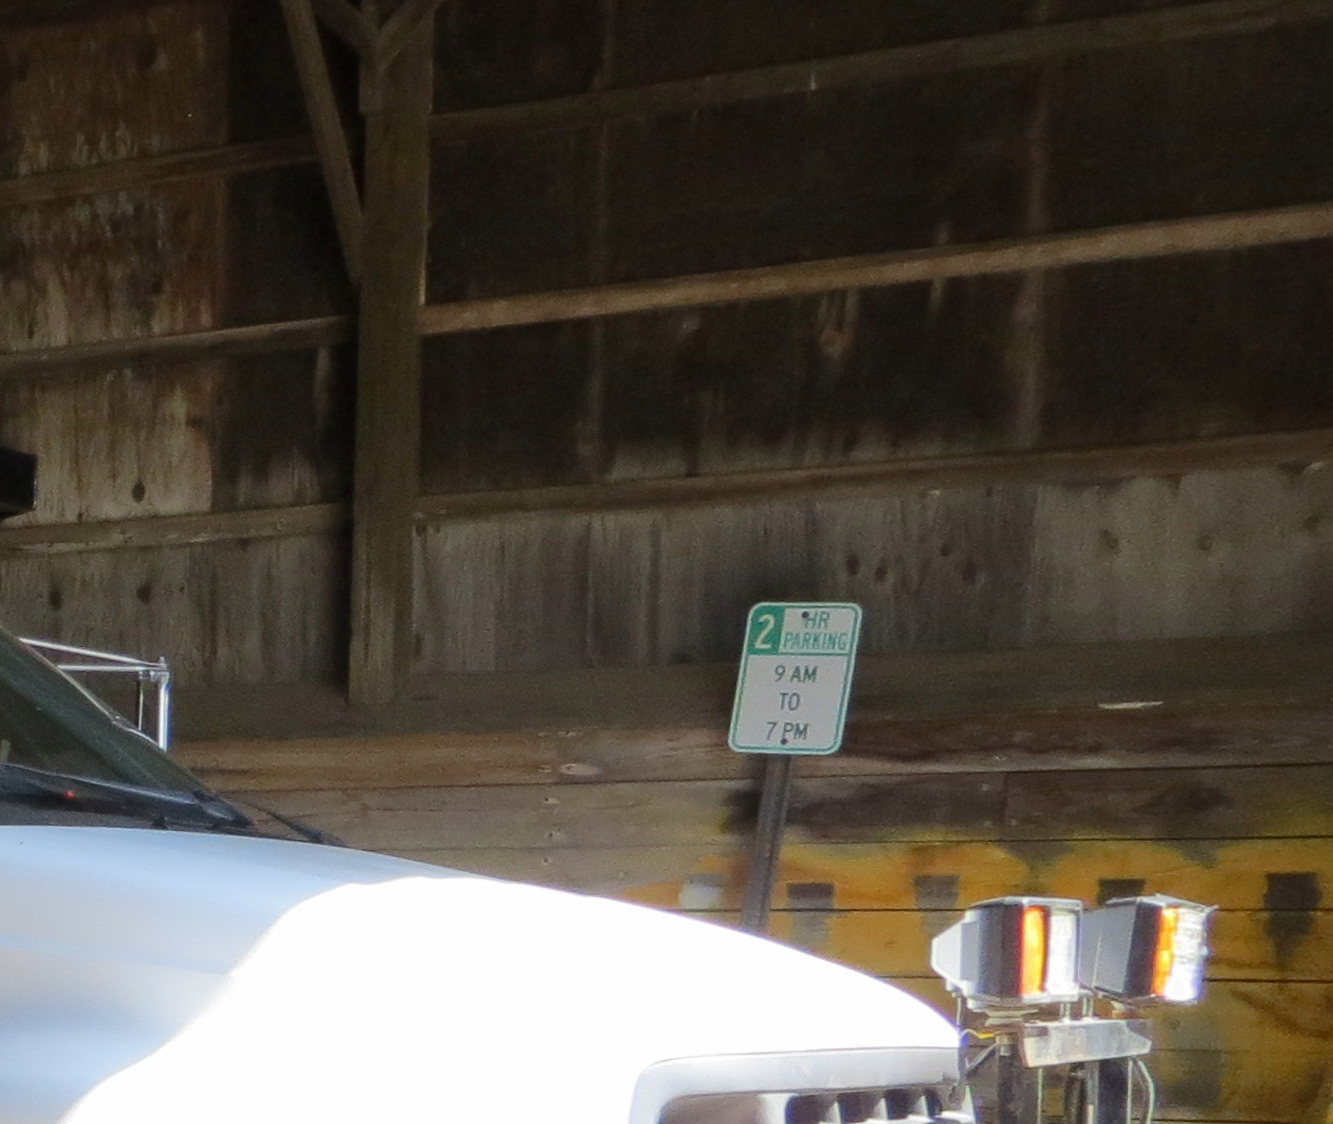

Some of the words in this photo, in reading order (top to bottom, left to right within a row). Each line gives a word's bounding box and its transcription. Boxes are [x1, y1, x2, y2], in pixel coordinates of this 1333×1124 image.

[754, 613, 776, 650] 2
[803, 610, 831, 629] HR
[782, 631, 849, 650] PARKING
[774, 664, 786, 683] 9
[790, 665, 818, 683] AM
[779, 692, 801, 711] TO
[765, 721, 777, 741] 7
[782, 721, 809, 741] PM
